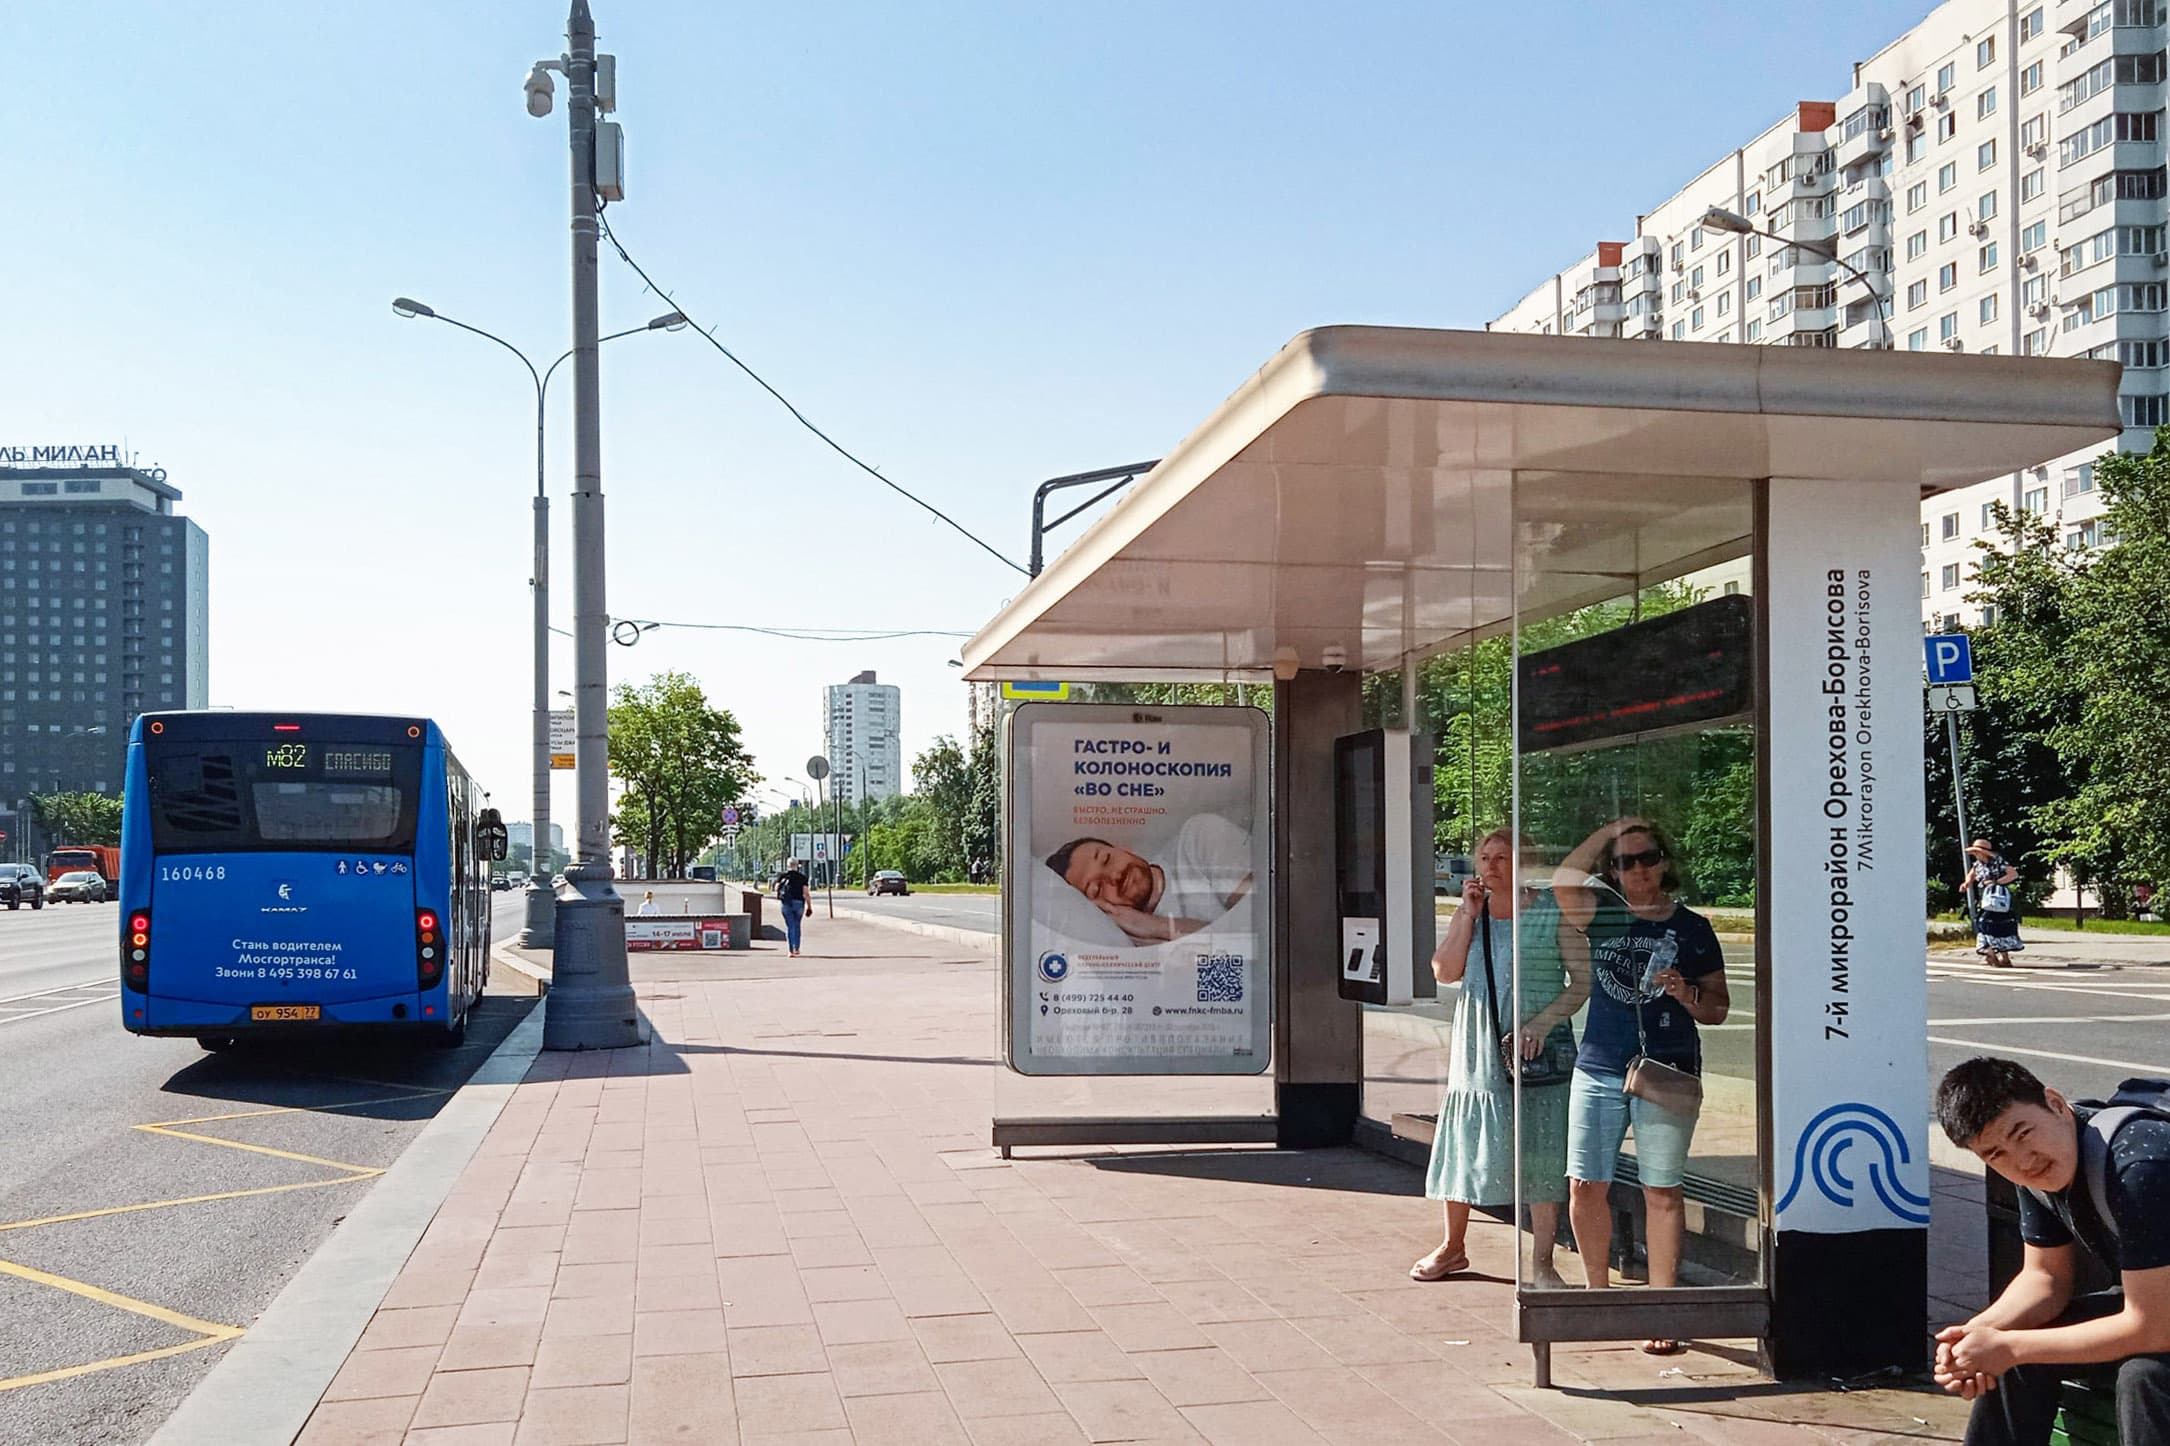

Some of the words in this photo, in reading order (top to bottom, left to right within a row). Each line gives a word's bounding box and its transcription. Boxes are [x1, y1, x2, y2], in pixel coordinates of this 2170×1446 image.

[32, 445, 118, 462] МИЛАН
[1854, 569, 1872, 744] Orekhova-Borisova
[1936, 641, 1960, 678] P
[1822, 568, 1852, 820] Орехова-Борисова
[1074, 740, 1153, 755] ГАСТРО-
[1157, 742, 1171, 755] И
[325, 752, 391, 771] СПАСИБО
[1074, 760, 1232, 778] КОЛОНОСКОПИЯ
[1074, 783, 1112, 797] «ВО
[1117, 783, 1165, 798] СНЕ»
[161, 866, 227, 881] 160468
[1823, 826, 1854, 994] микрорайон
[232, 938, 269, 952] Стань
[272, 940, 343, 953] водителем
[238, 953, 336, 967] Мосгортранса!
[215, 967, 255, 980] Звони
[257, 967, 266, 979] 8
[268, 967, 294, 980] 495
[296, 967, 323, 980] 398
[324, 967, 341, 980] 67
[343, 967, 358, 980] 61
[1053, 993, 1060, 1002] 8
[1061, 993, 1087, 1003] (499)
[1088, 993, 1105, 1002] 725
[1106, 993, 1120, 1002] 44
[1121, 993, 1135, 1002] 40
[276, 1008, 299, 1019] 954
[304, 1007, 316, 1016] 77
[1053, 1005, 1100, 1016] Ореховый
[1164, 1005, 1244, 1016] www.fnkc-fmba.ru
[1825, 1002, 1849, 1041] 7-й
